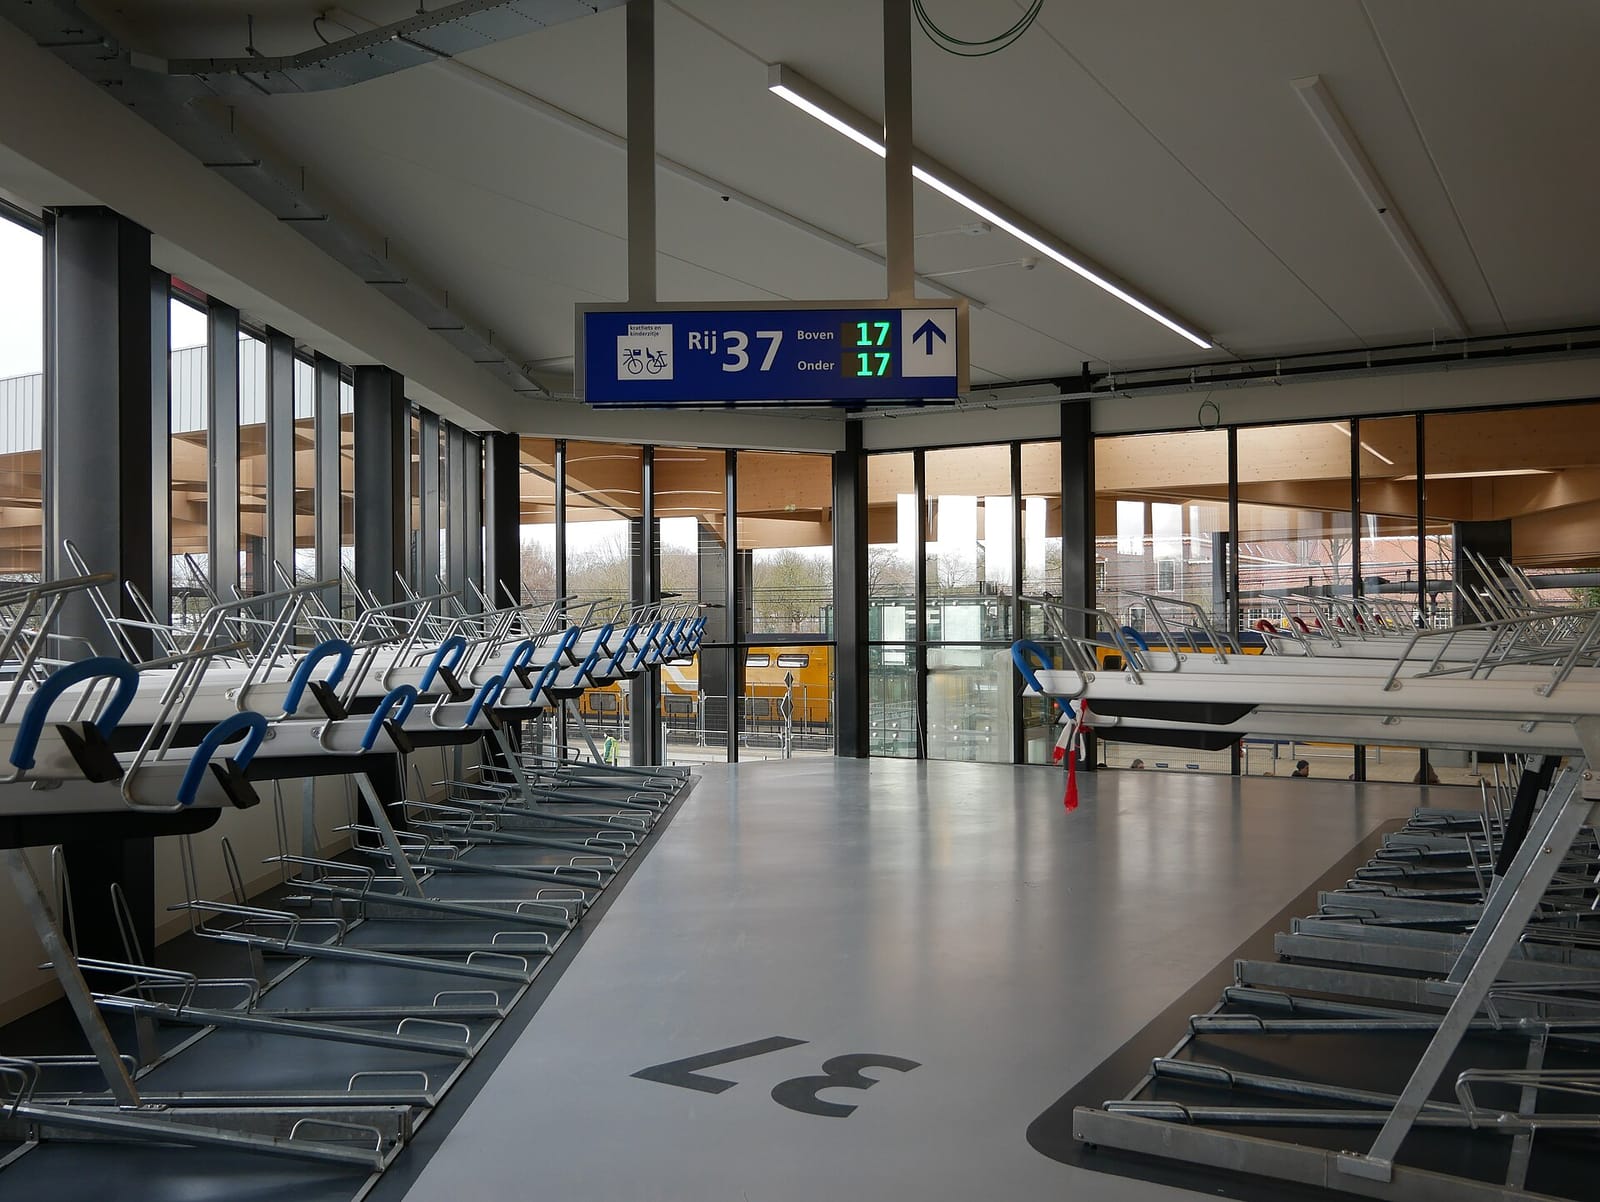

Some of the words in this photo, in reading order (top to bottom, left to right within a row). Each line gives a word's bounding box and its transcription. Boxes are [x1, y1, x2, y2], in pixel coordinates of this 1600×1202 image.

[797, 330, 834, 340] Boven
[856, 322, 890, 346] 17
[688, 330, 717, 354] Rij
[722, 330, 783, 372] 37
[797, 360, 835, 371] Onder
[857, 352, 891, 376] 17
[629, 1036, 923, 1118] 37
